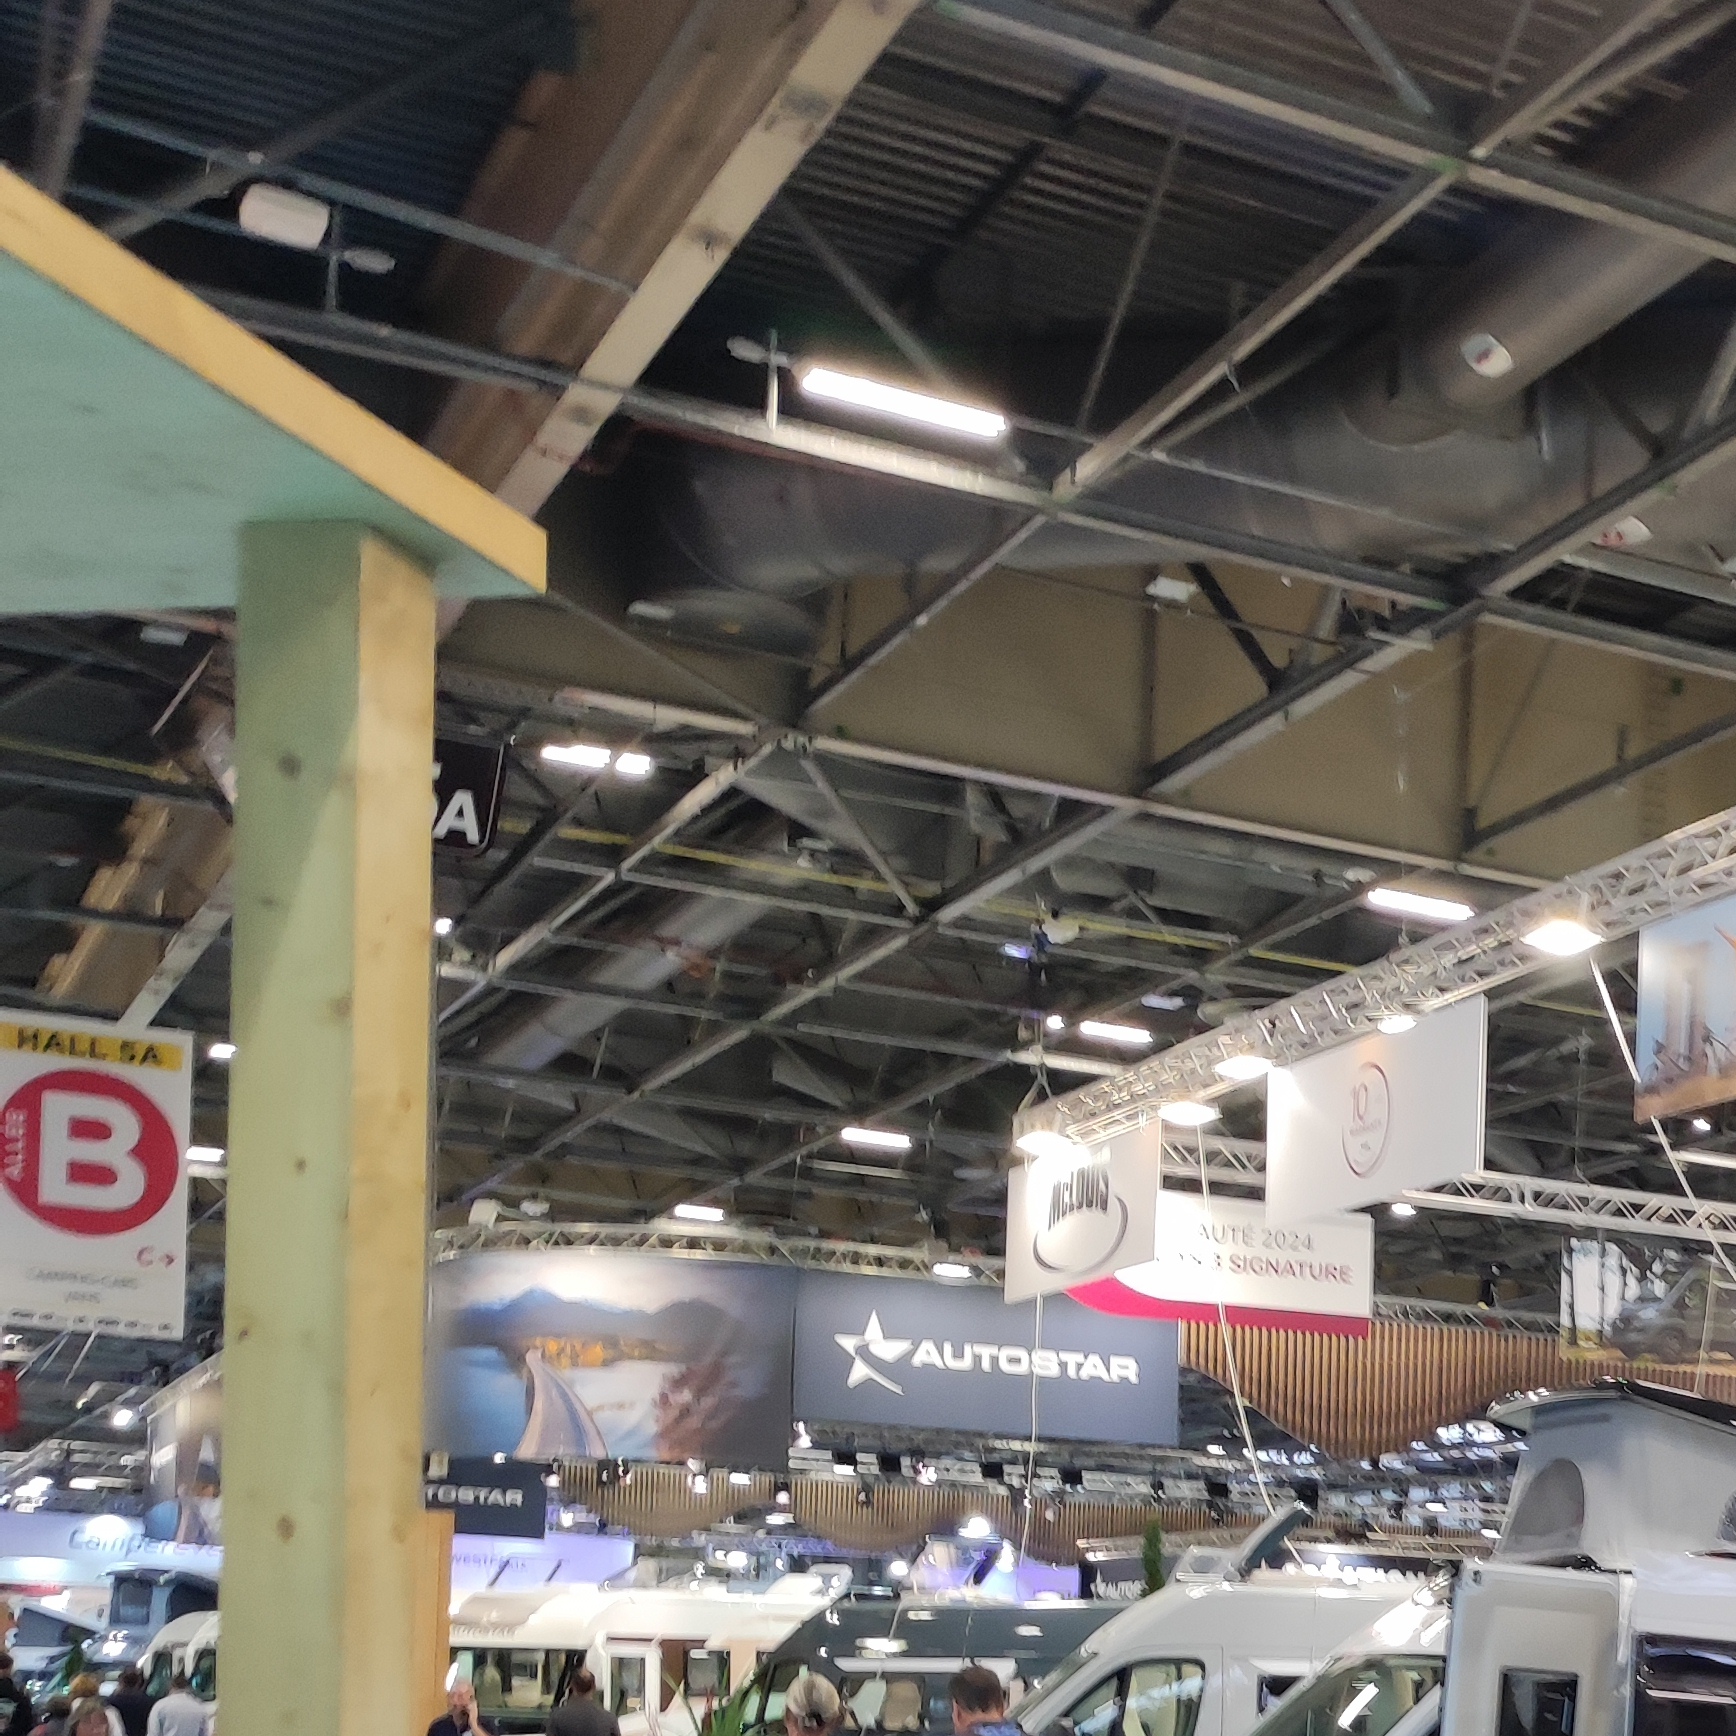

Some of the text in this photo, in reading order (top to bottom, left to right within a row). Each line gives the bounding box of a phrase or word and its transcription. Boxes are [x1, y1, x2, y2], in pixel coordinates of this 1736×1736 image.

[17, 1026, 107, 1061] HALL
[37, 1088, 147, 1212] B
[1261, 1227, 1315, 1252] 2024
[1228, 1254, 1354, 1286] SIGNATURE
[910, 1337, 1140, 1385] AUTOSTAR
